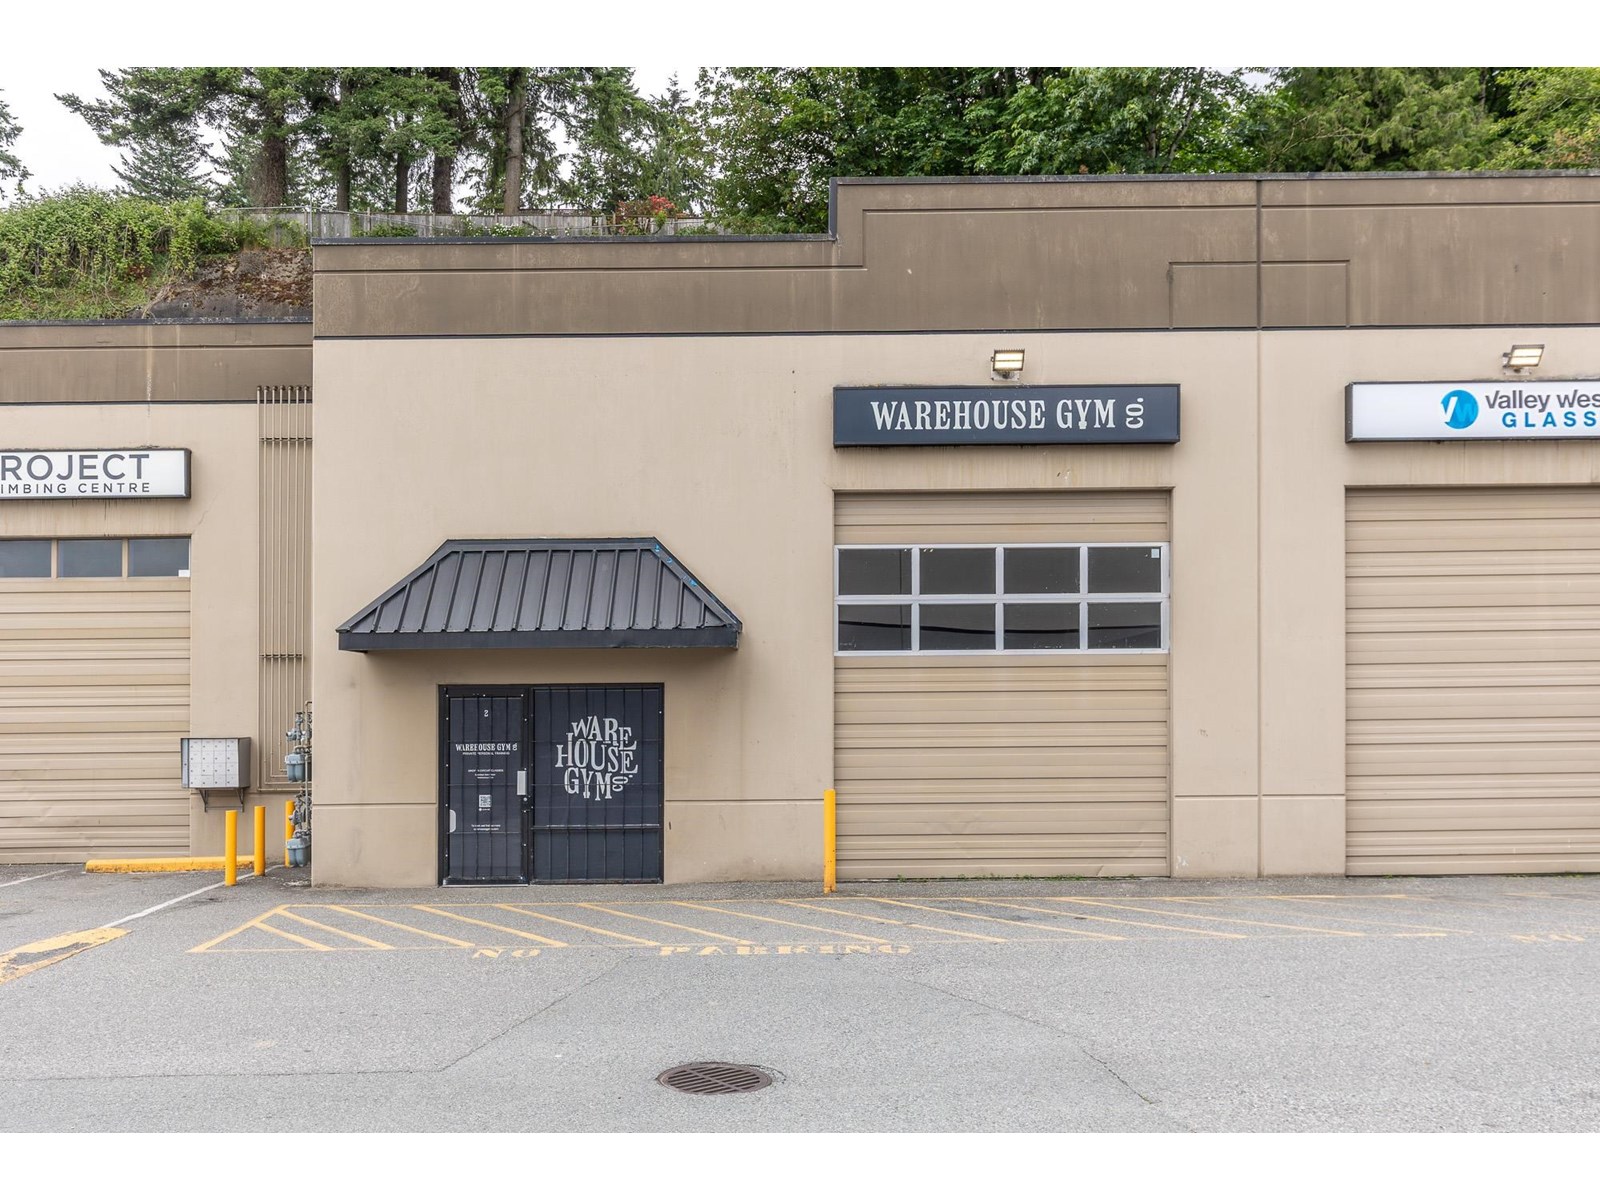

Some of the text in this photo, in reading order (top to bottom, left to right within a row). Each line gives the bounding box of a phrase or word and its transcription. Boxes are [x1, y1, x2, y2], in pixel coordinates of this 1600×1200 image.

[1485, 390, 1551, 413] Valley
[870, 400, 1046, 430] WAREHOUSE
[1056, 399, 1116, 430] GYM
[1502, 411, 1597, 428] GLASS
[0, 453, 150, 481] ROJECT
[78, 482, 150, 494] CENTRE
[496, 743, 511, 751] GYM
[564, 767, 612, 801] GYM
[471, 944, 911, 959] NO PARKING
